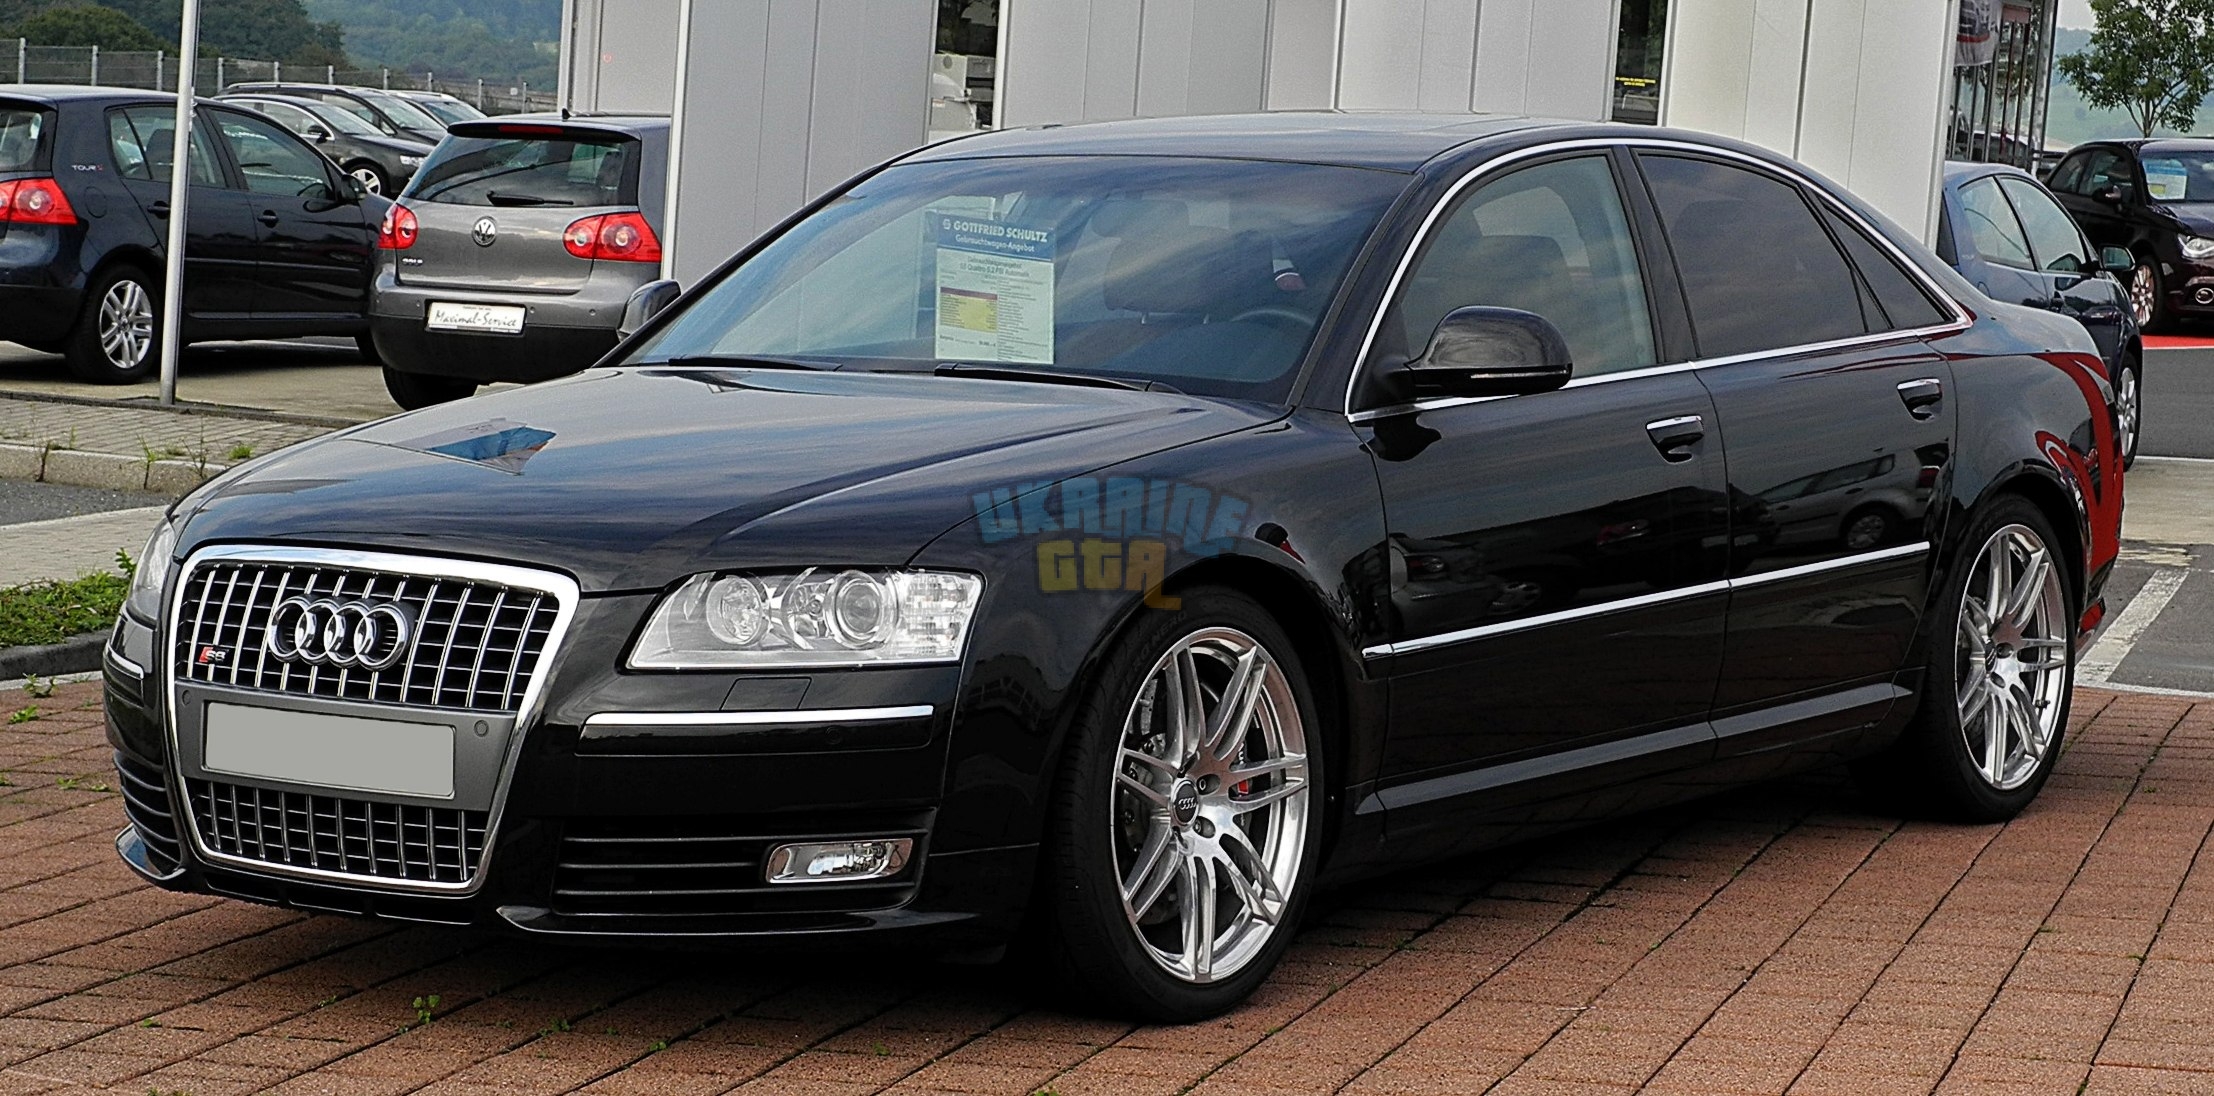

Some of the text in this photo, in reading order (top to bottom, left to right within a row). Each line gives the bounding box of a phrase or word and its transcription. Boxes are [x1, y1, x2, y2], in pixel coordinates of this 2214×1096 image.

[953, 220, 1048, 243] GOTTFRIED SCHULTZ
[955, 234, 1036, 253] Gebrauchtwagen-Angebot
[434, 309, 517, 328] Maximal-Service
